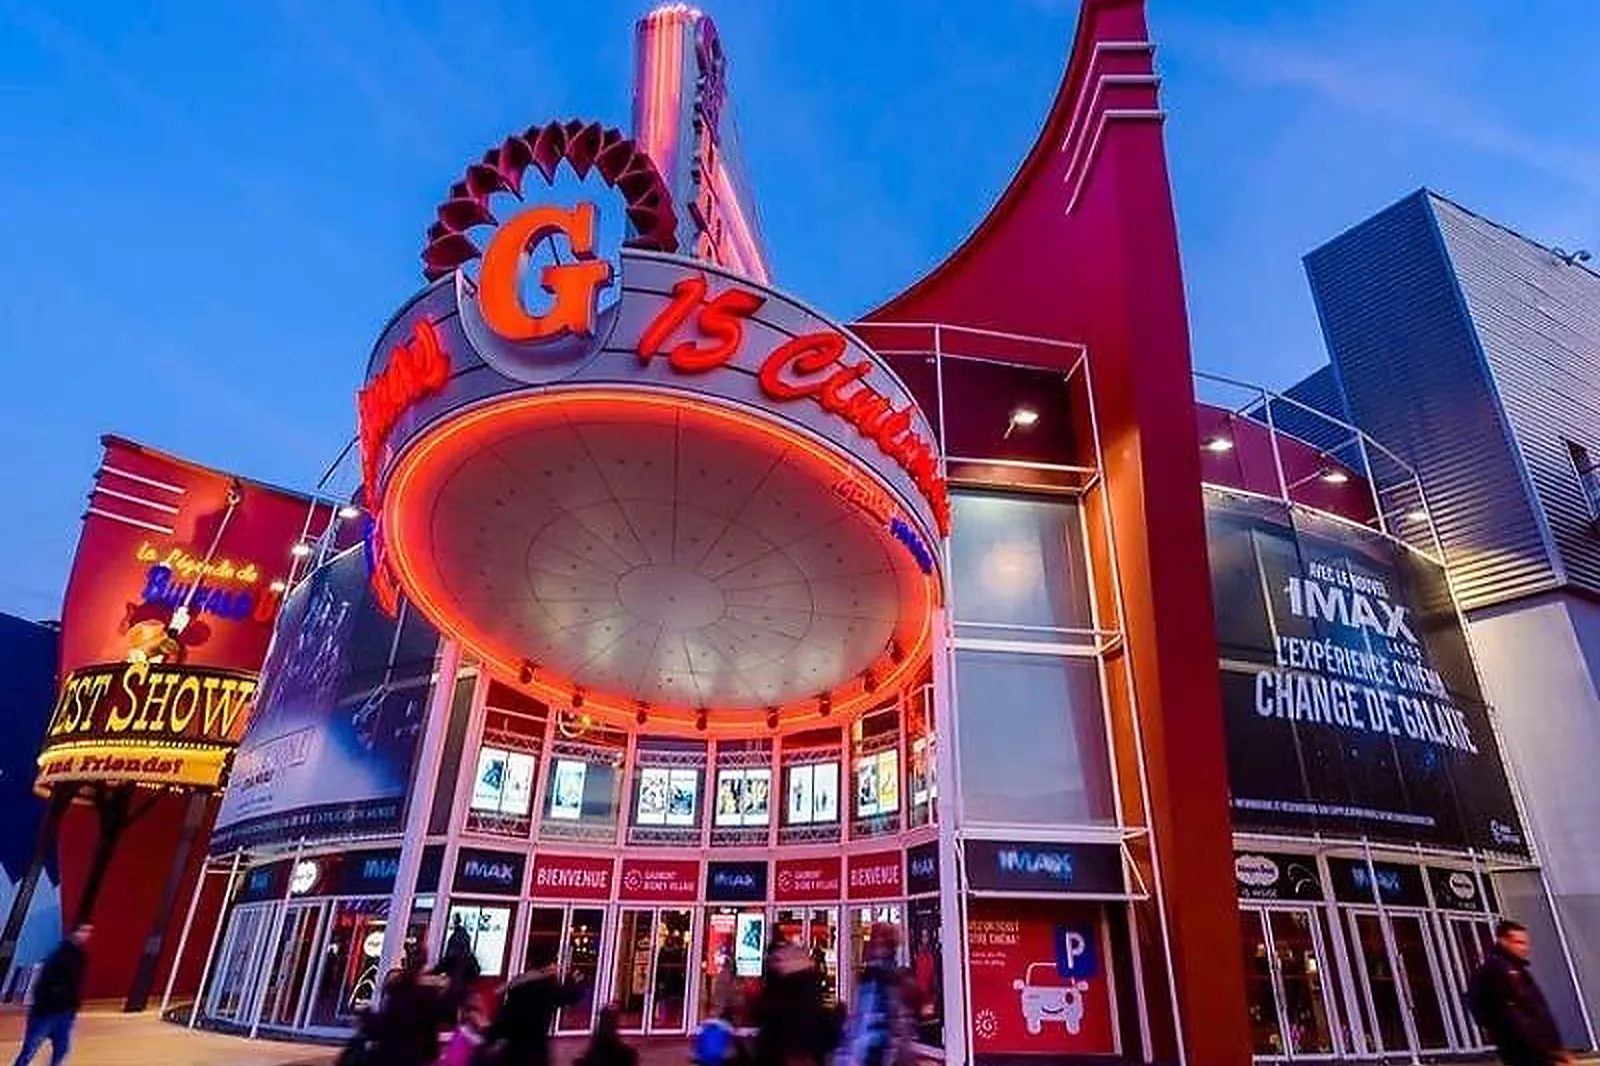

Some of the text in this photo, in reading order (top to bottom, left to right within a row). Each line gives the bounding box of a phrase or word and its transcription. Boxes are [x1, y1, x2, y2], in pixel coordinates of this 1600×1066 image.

[479, 202, 612, 343] G
[637, 273, 767, 374] 15
[1286, 576, 1419, 644] IMAX
[1276, 634, 1396, 687] L'EXPÉRIENCE
[1255, 670, 1365, 729] CHANGE
[1364, 686, 1401, 736] DE
[463, 859, 515, 881] IMAX
[536, 867, 609, 889] BIENVENUE
[850, 864, 900, 888] BIENVENUE
[997, 850, 1074, 874] IMAX
[1065, 931, 1086, 970] P
